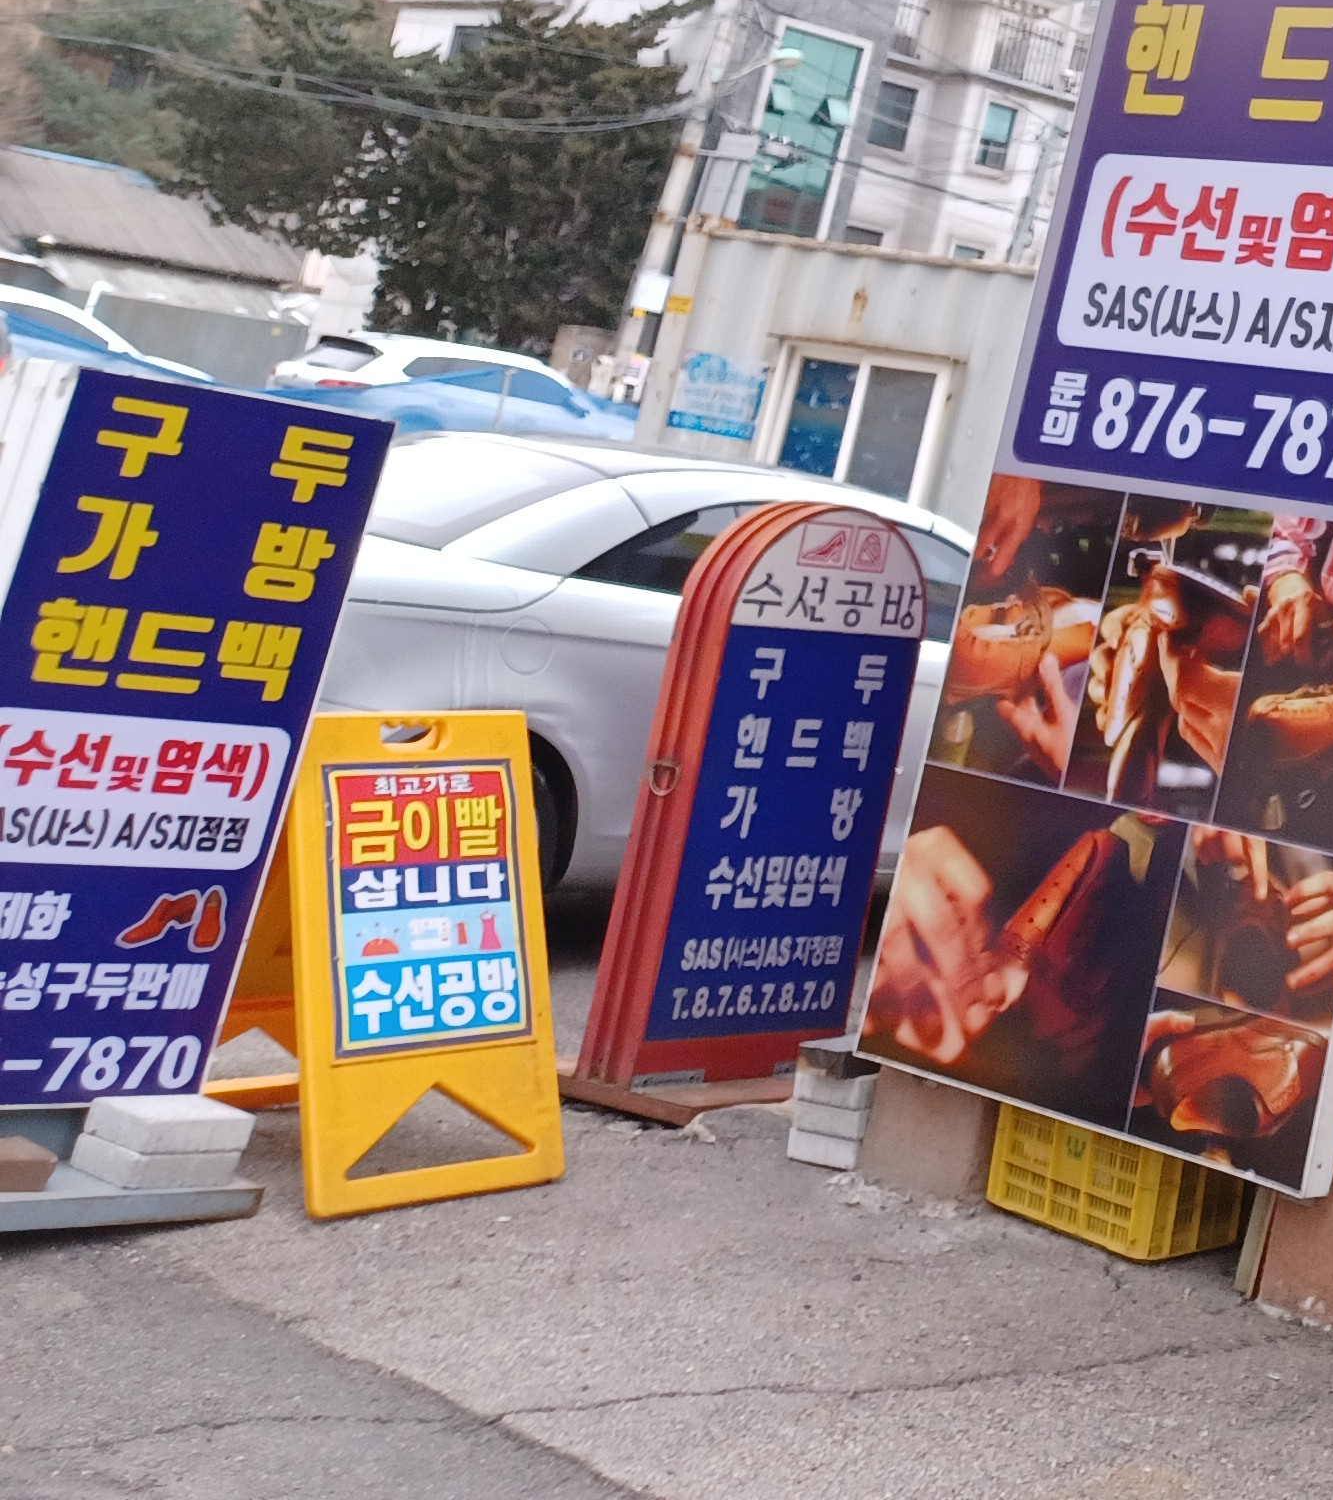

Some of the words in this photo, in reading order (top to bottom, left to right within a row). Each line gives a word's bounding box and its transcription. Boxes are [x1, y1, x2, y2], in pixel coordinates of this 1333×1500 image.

[1082, 282, 1240, 346] SAS(사스)
[1039, 369, 1089, 447] 문의
[741, 572, 926, 631] 수선공방
[29, 596, 303, 703] 핸드백
[0, 723, 271, 802] 수선및염색)
[345, 794, 504, 866] 금이빨
[0, 962, 211, 1012] 성구두판매
[351, 956, 518, 1035] 수선공방
